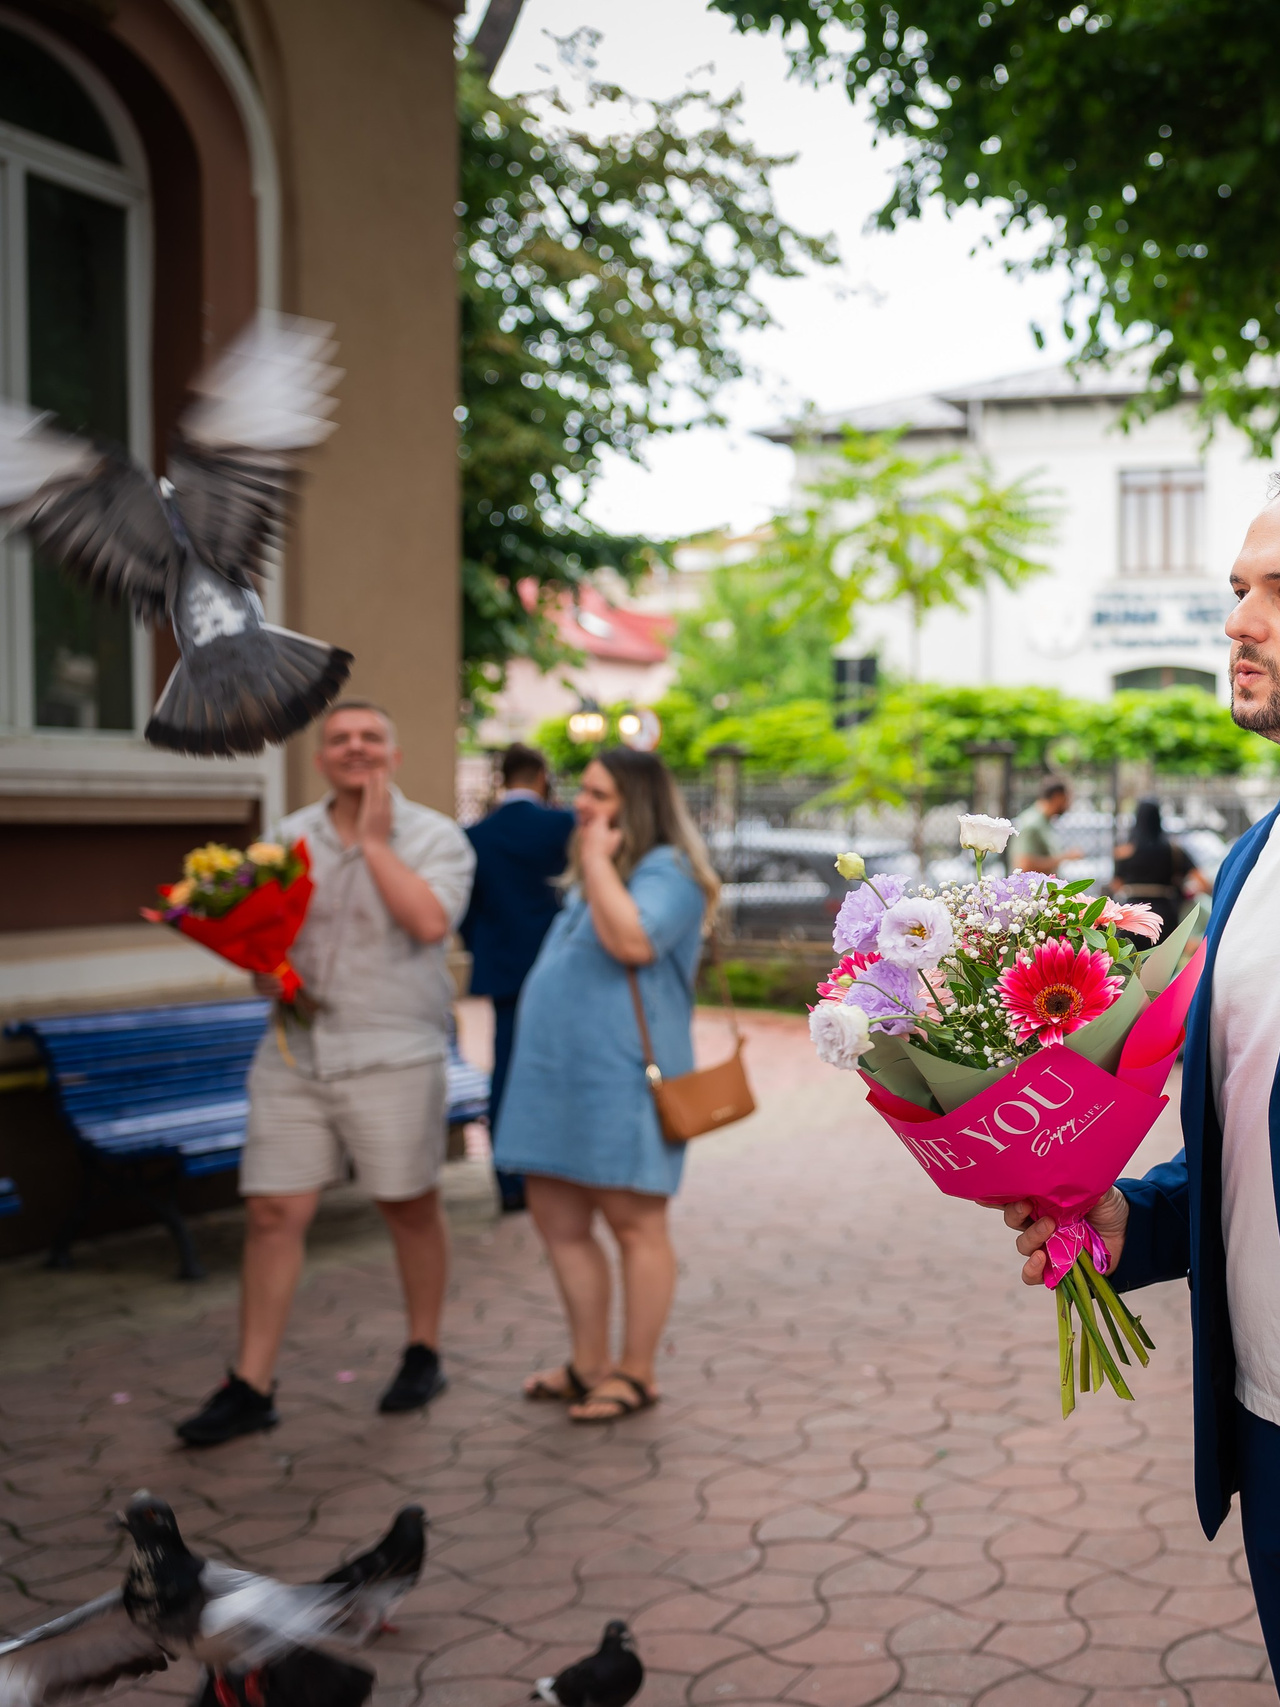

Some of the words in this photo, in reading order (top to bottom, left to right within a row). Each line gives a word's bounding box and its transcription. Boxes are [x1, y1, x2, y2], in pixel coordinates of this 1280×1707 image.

[900, 1133, 977, 1171] OVE
[956, 1066, 1075, 1154] YOU
[1030, 1117, 1076, 1157] Enjoy
[1078, 1103, 1103, 1124] LIFE
